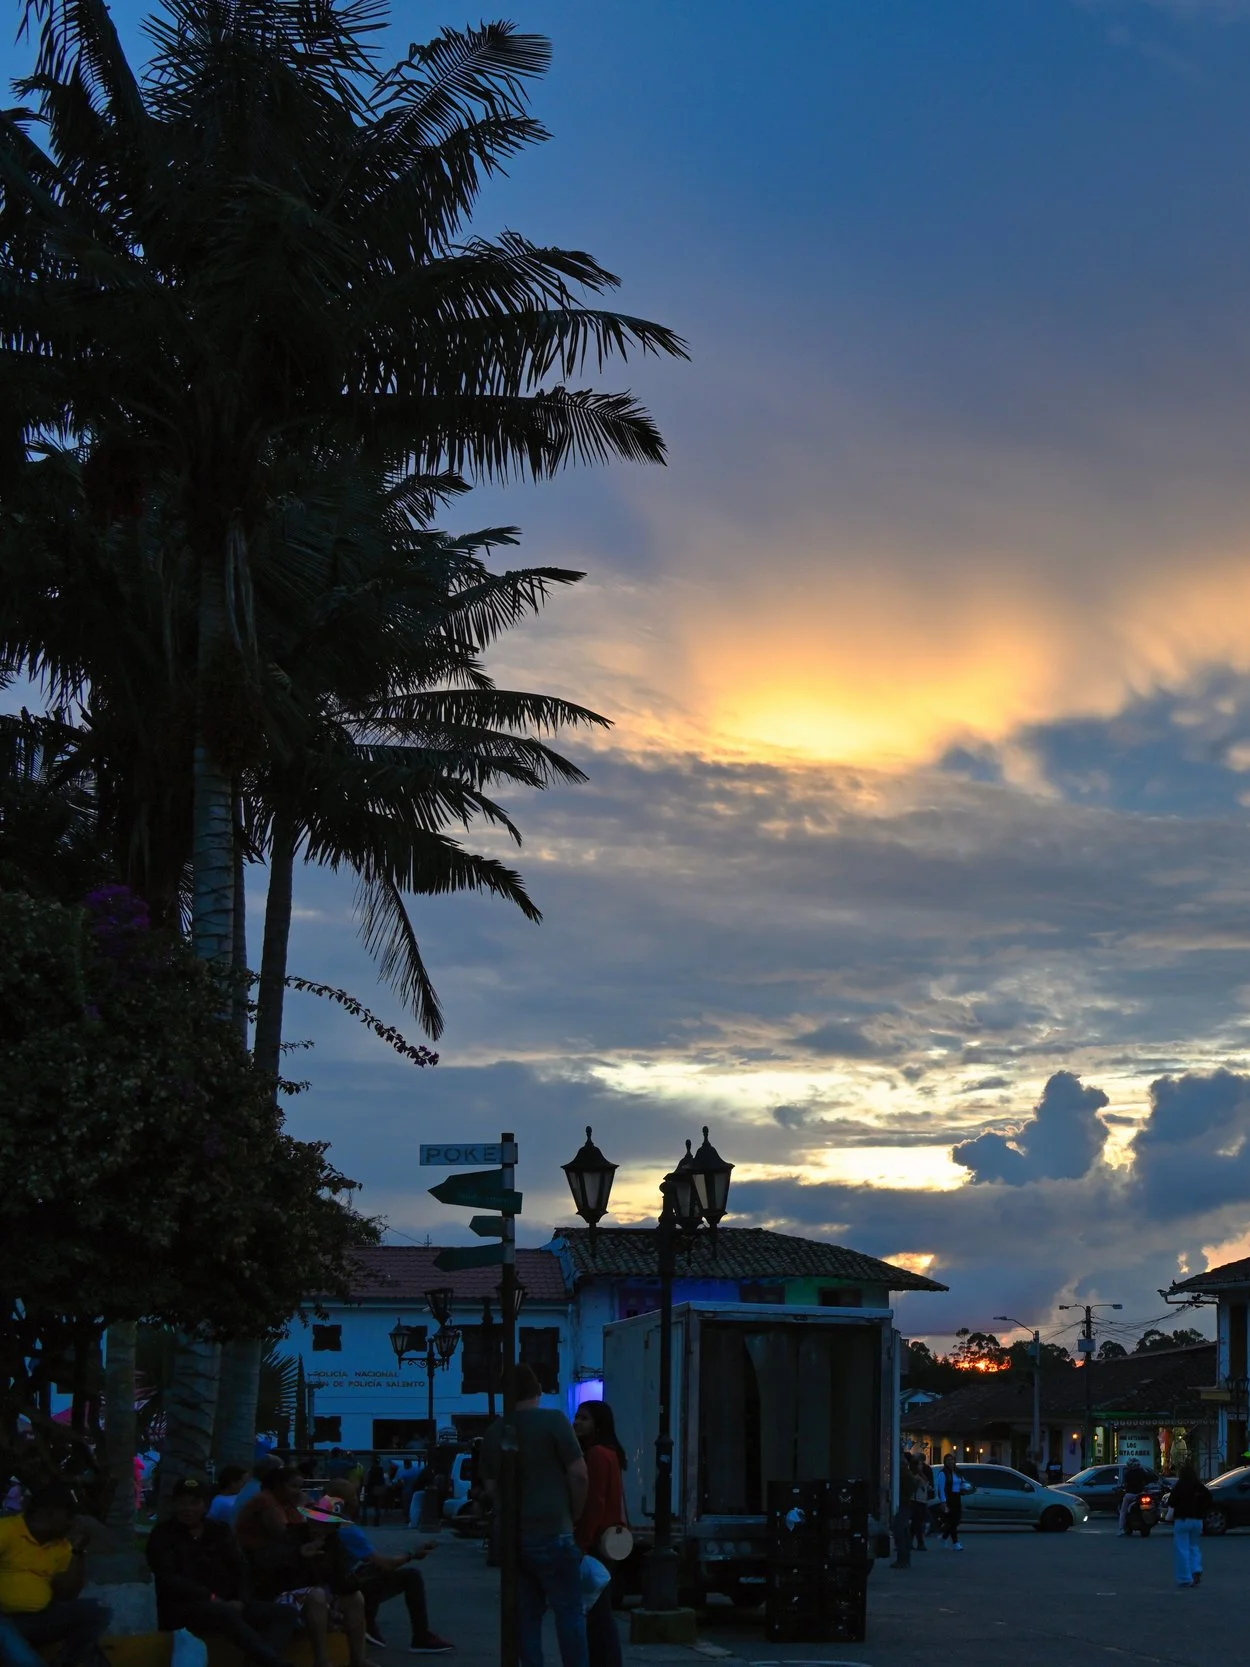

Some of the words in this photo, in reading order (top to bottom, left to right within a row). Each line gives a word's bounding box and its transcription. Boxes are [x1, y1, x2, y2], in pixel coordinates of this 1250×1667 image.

[425, 1146, 497, 1163] POKE
[354, 1370, 399, 1378] NACIONAL
[386, 1380, 425, 1388] SALENTO
